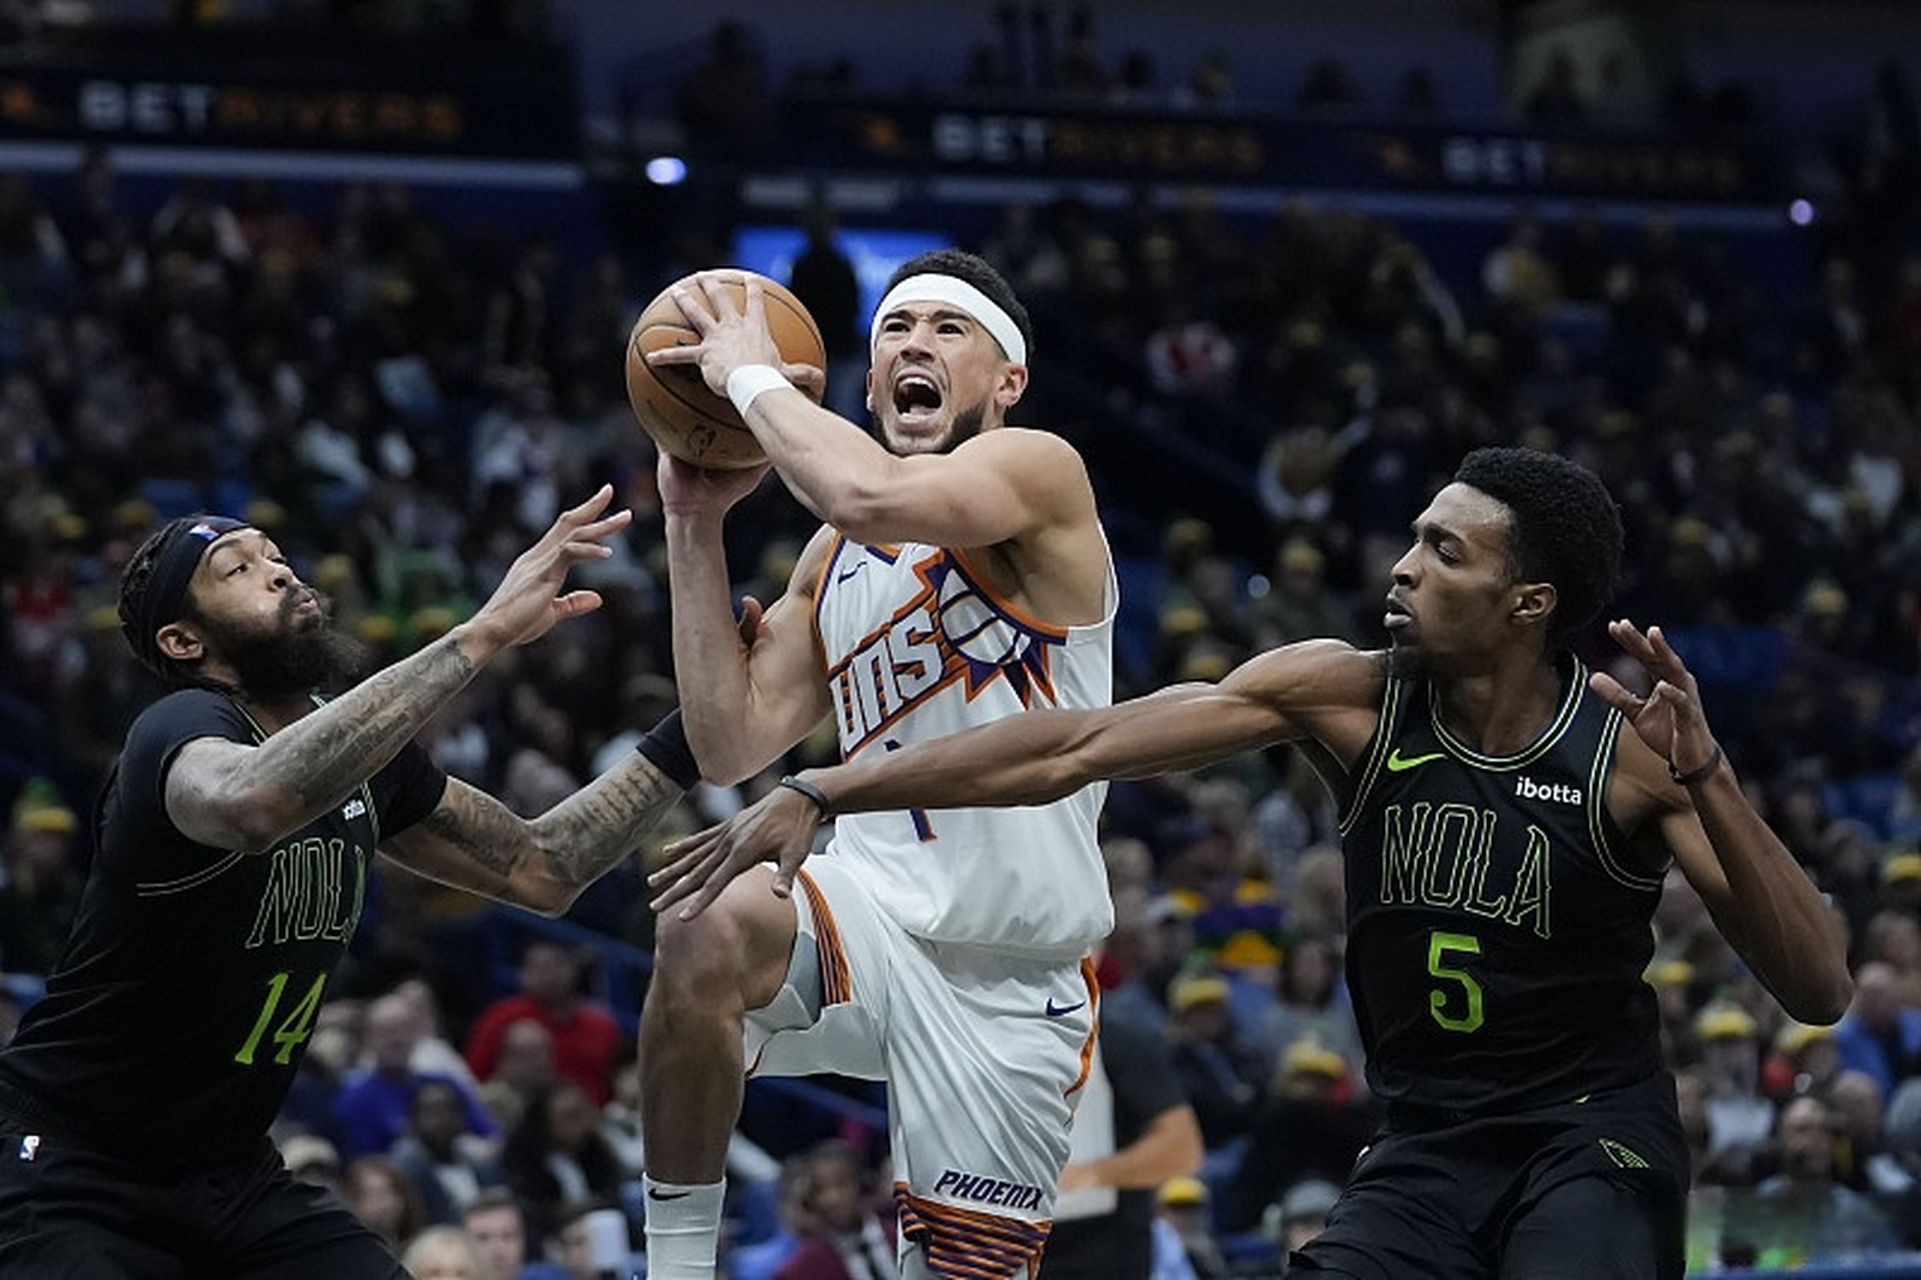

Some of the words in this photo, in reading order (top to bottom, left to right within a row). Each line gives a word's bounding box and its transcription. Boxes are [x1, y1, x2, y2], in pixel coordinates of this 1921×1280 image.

[79, 81, 463, 136] BETRVERS
[930, 114, 1262, 170] BETRVERS
[829, 607, 945, 753] UNS
[1515, 776, 1582, 805] ibotta
[1380, 802, 1552, 939] NOLA
[234, 972, 328, 1065] 14
[1428, 931, 1485, 1033] 5
[934, 1169, 1045, 1211] PHOENIX
